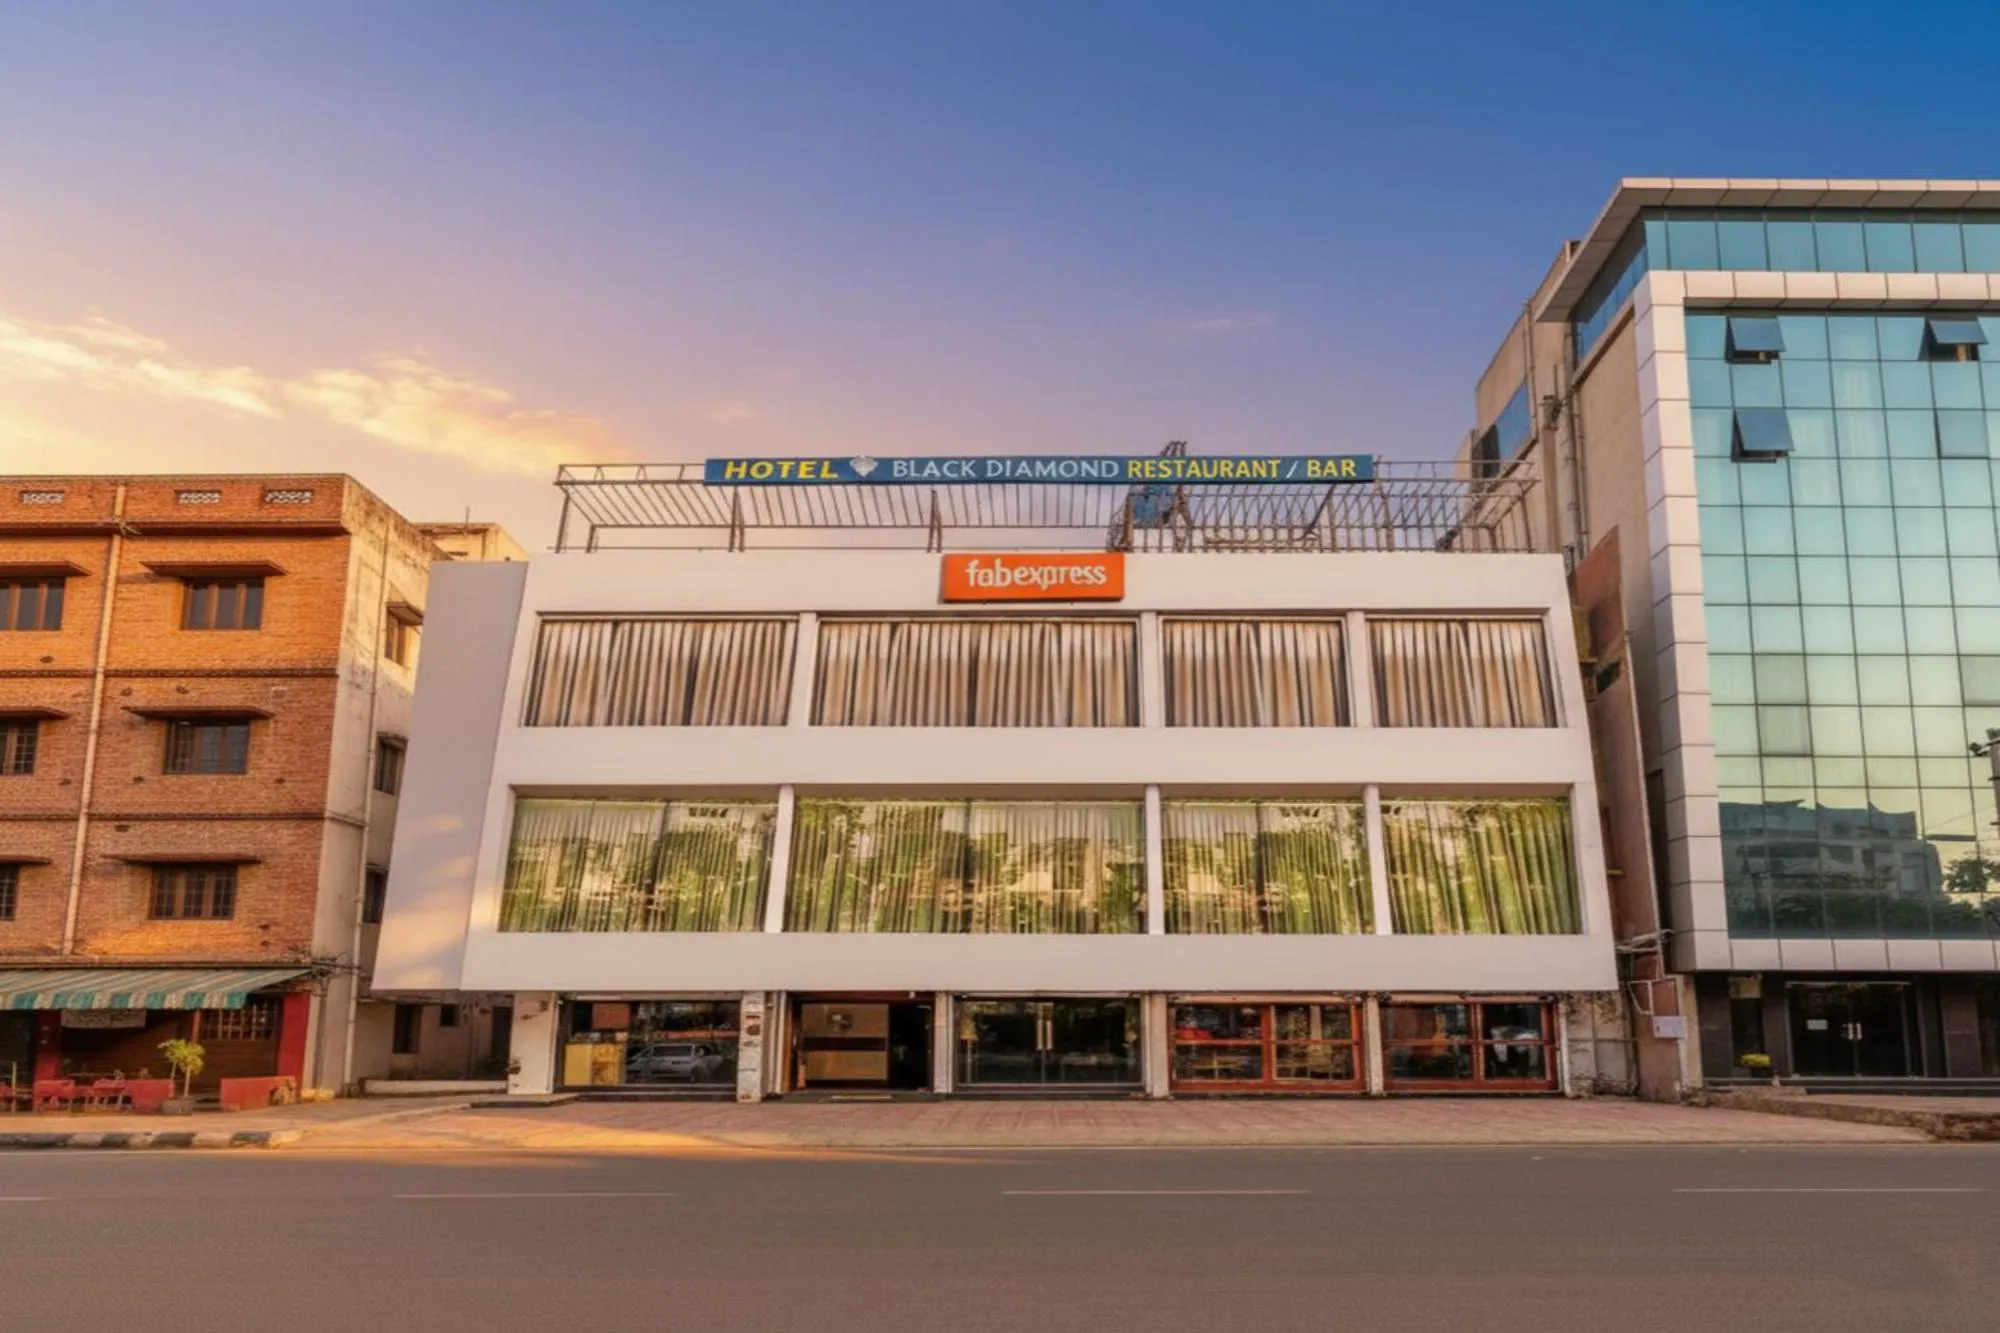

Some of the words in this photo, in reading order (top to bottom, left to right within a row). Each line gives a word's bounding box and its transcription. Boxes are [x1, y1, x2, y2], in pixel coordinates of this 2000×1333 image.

[723, 460, 839, 480] HOTEL
[892, 459, 977, 478] BLACK
[986, 459, 1119, 478] DIAMOND
[1127, 459, 1281, 479] RESTAURANT
[1286, 460, 1298, 479] /
[1306, 459, 1357, 478] BAR
[966, 558, 1108, 591] fabexpress
